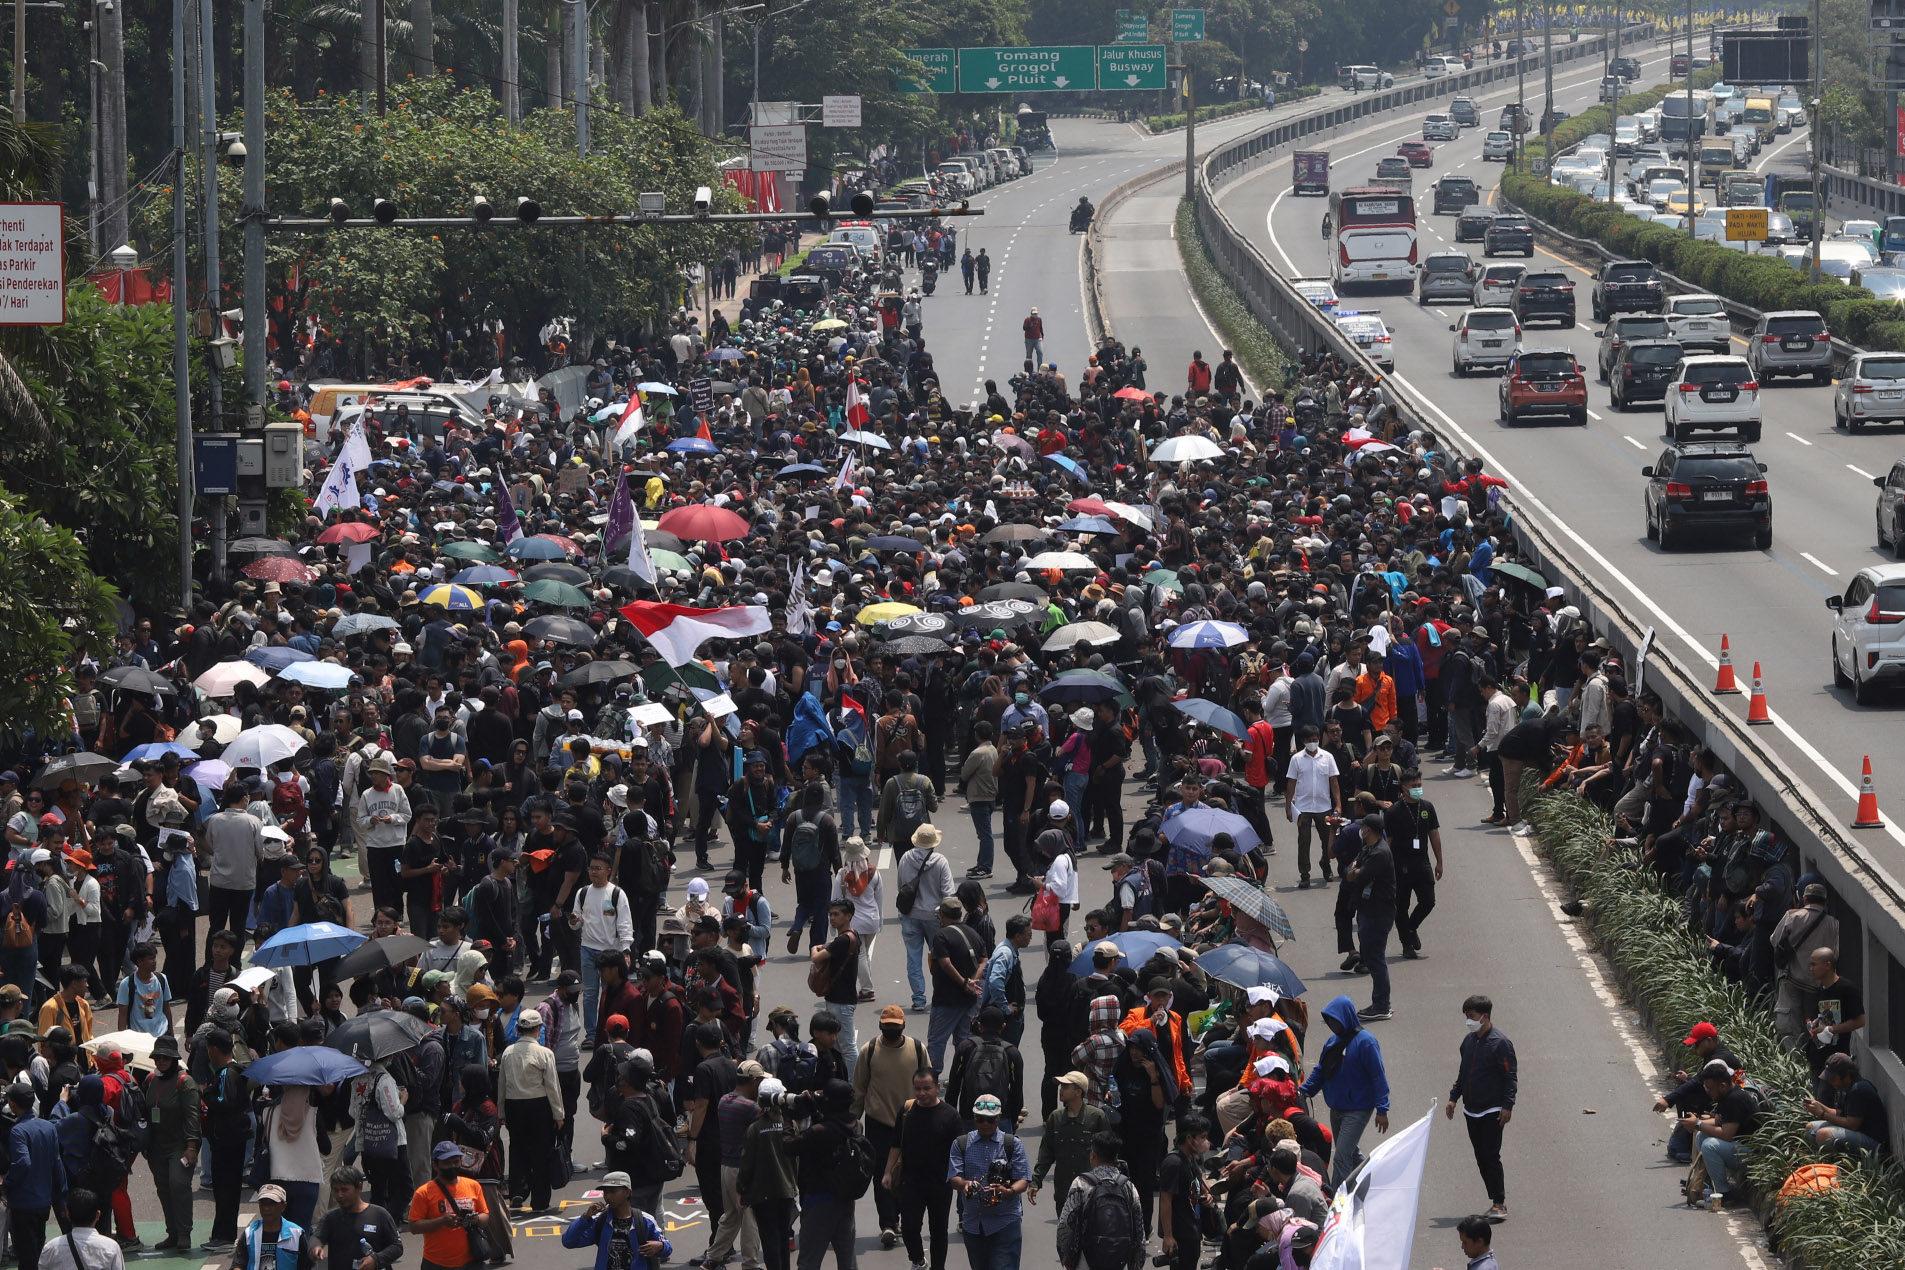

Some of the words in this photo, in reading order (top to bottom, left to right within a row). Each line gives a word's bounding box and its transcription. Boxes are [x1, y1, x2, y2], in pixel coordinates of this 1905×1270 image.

[995, 52, 1060, 62] Tomang
[1103, 51, 1125, 59] Jalur
[1128, 50, 1162, 59] Khusus
[998, 63, 1056, 73] Grogol
[1110, 62, 1154, 72] Busway
[1008, 74, 1046, 84] Pluit
[15, 239, 54, 254] Terdapat
[10, 258, 36, 271] Parkir
[7, 277, 58, 290] Penderekan
[11, 296, 28, 308] Hari
